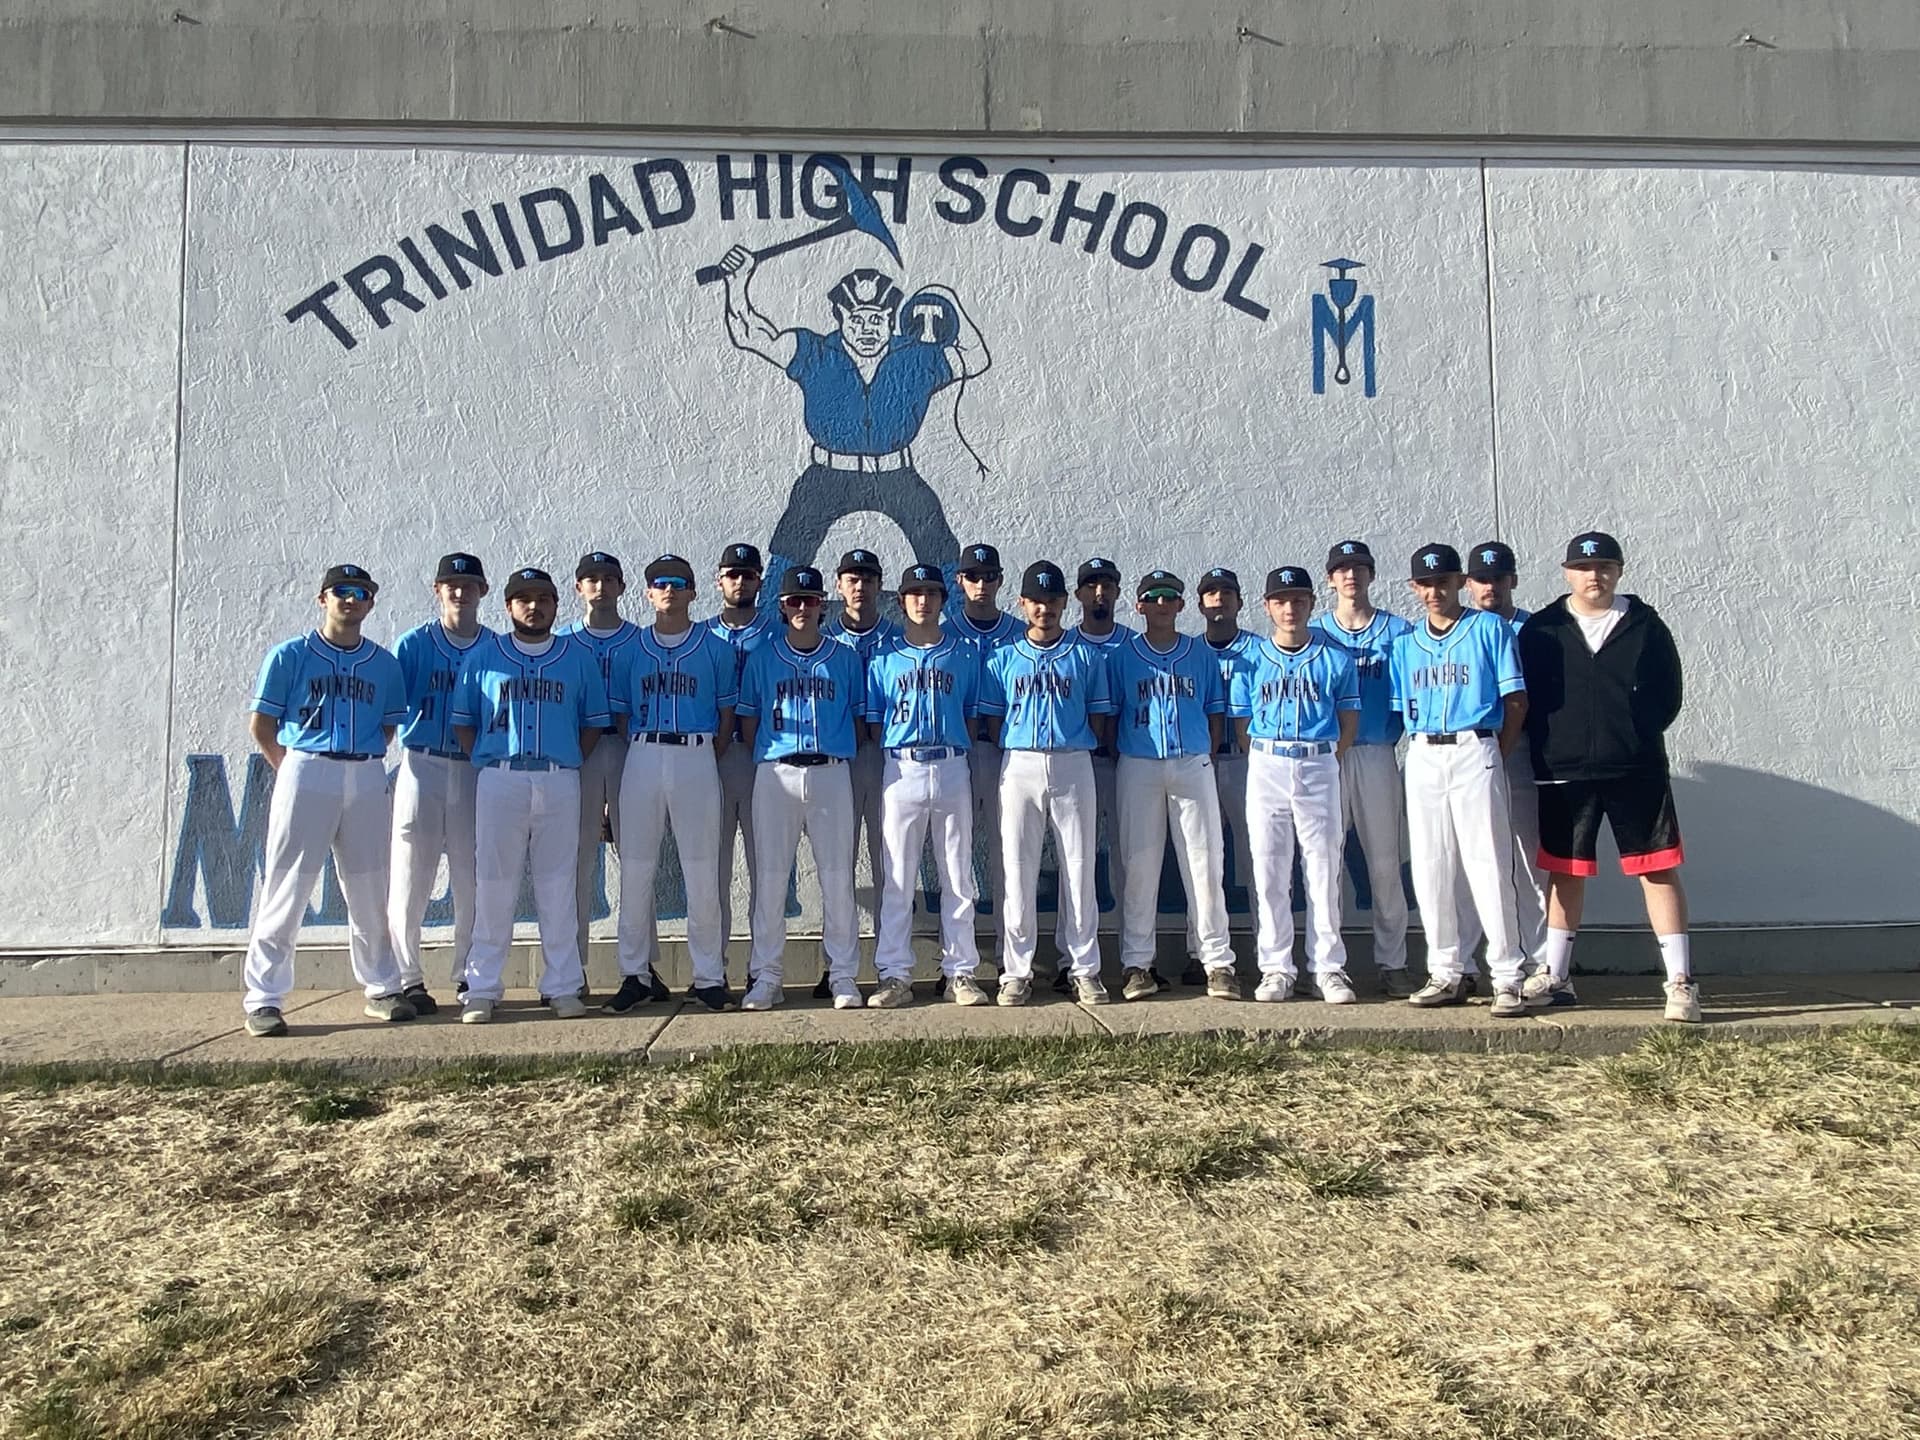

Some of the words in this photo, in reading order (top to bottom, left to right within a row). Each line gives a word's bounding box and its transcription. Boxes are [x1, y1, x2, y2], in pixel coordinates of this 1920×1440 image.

[285, 157, 697, 351] TRINIDAD
[716, 153, 912, 224] HIGH
[935, 156, 1270, 322] SCHOOL
[913, 304, 943, 343] T
[897, 668, 954, 694] MINERS
[1412, 663, 1470, 688] MINERS
[309, 675, 376, 705] MINERS
[499, 676, 566, 704] MINERS
[776, 676, 835, 702] MINERS
[1261, 676, 1320, 703] MINERS
[773, 708, 784, 731] 8
[891, 700, 910, 726] 26
[1408, 698, 1419, 721] 6
